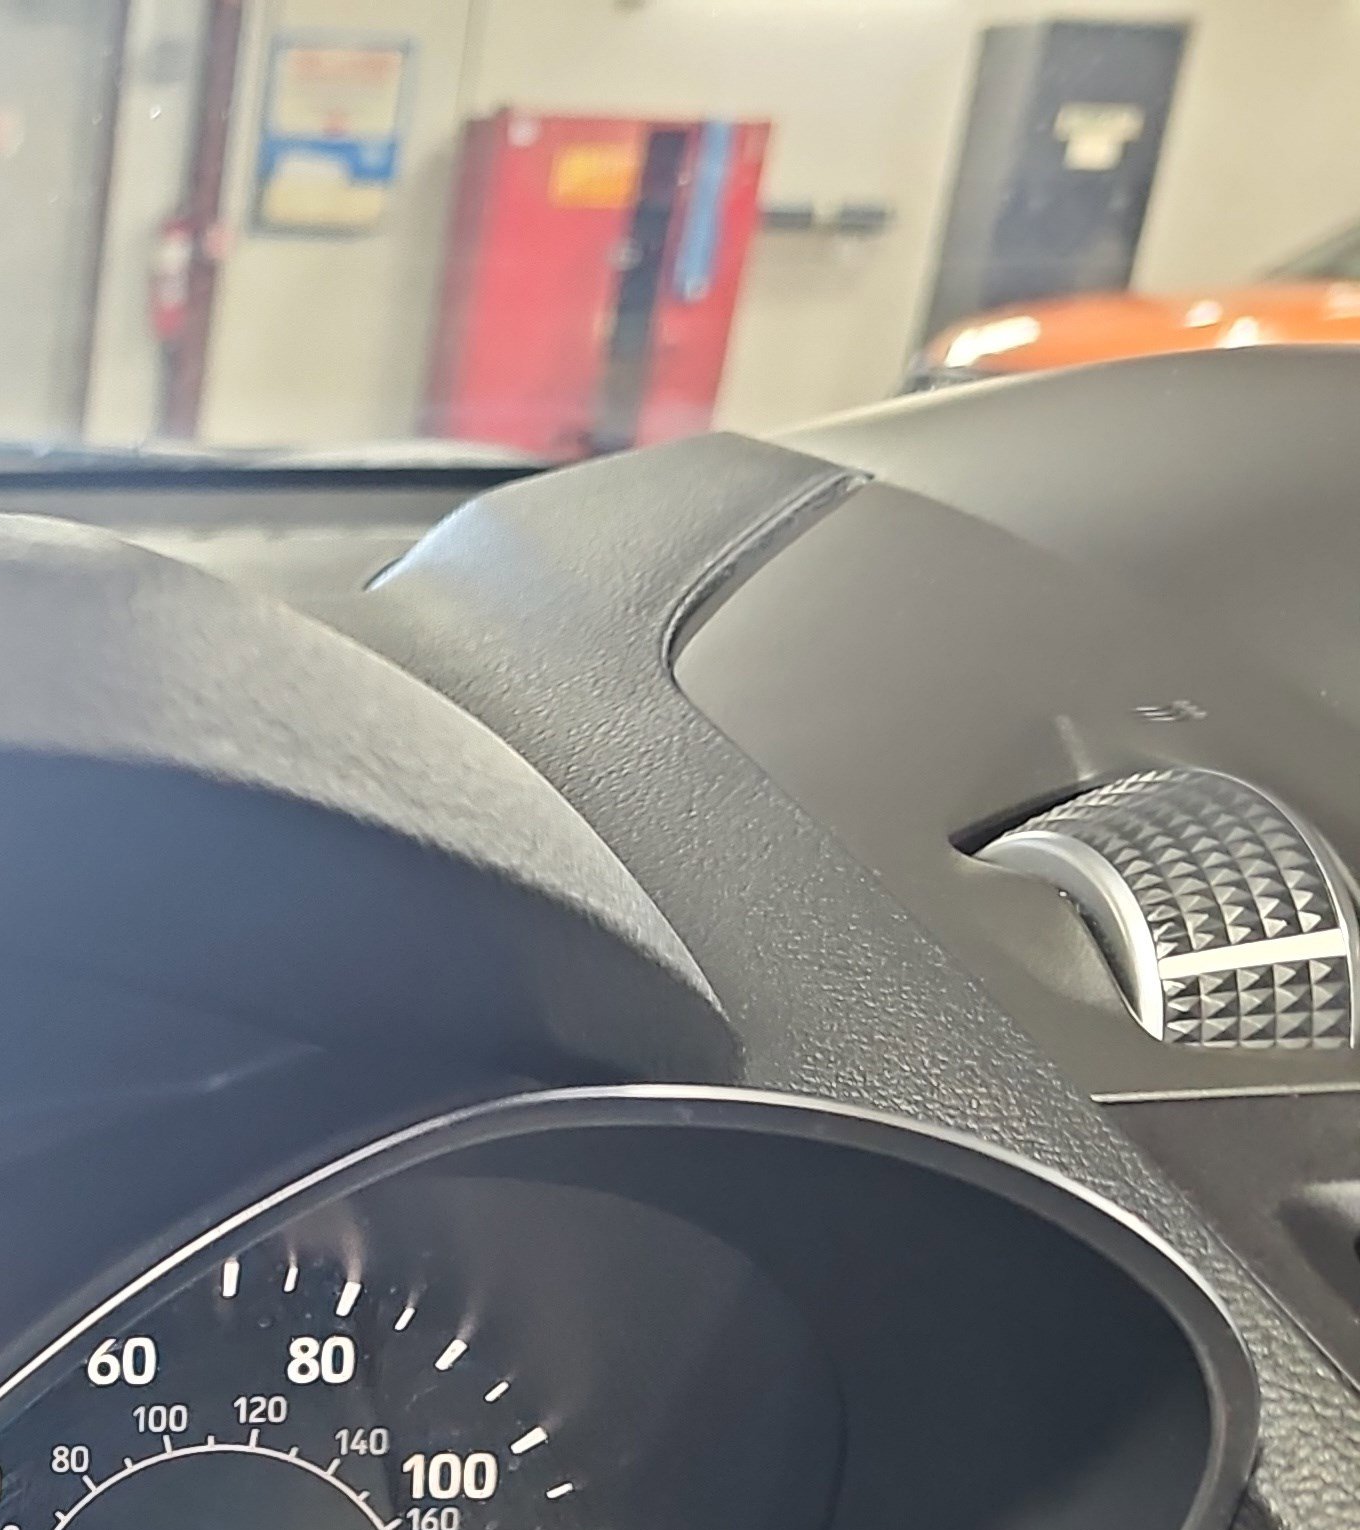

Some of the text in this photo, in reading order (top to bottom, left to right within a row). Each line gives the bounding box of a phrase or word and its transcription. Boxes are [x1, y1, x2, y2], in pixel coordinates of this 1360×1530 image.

[87, 1337, 157, 1385] 60
[287, 1335, 355, 1384] 80
[132, 1404, 188, 1433] 100
[233, 1396, 287, 1424] 120
[335, 1428, 389, 1456] 140
[51, 1445, 89, 1473] 80
[402, 1452, 497, 1499] 100
